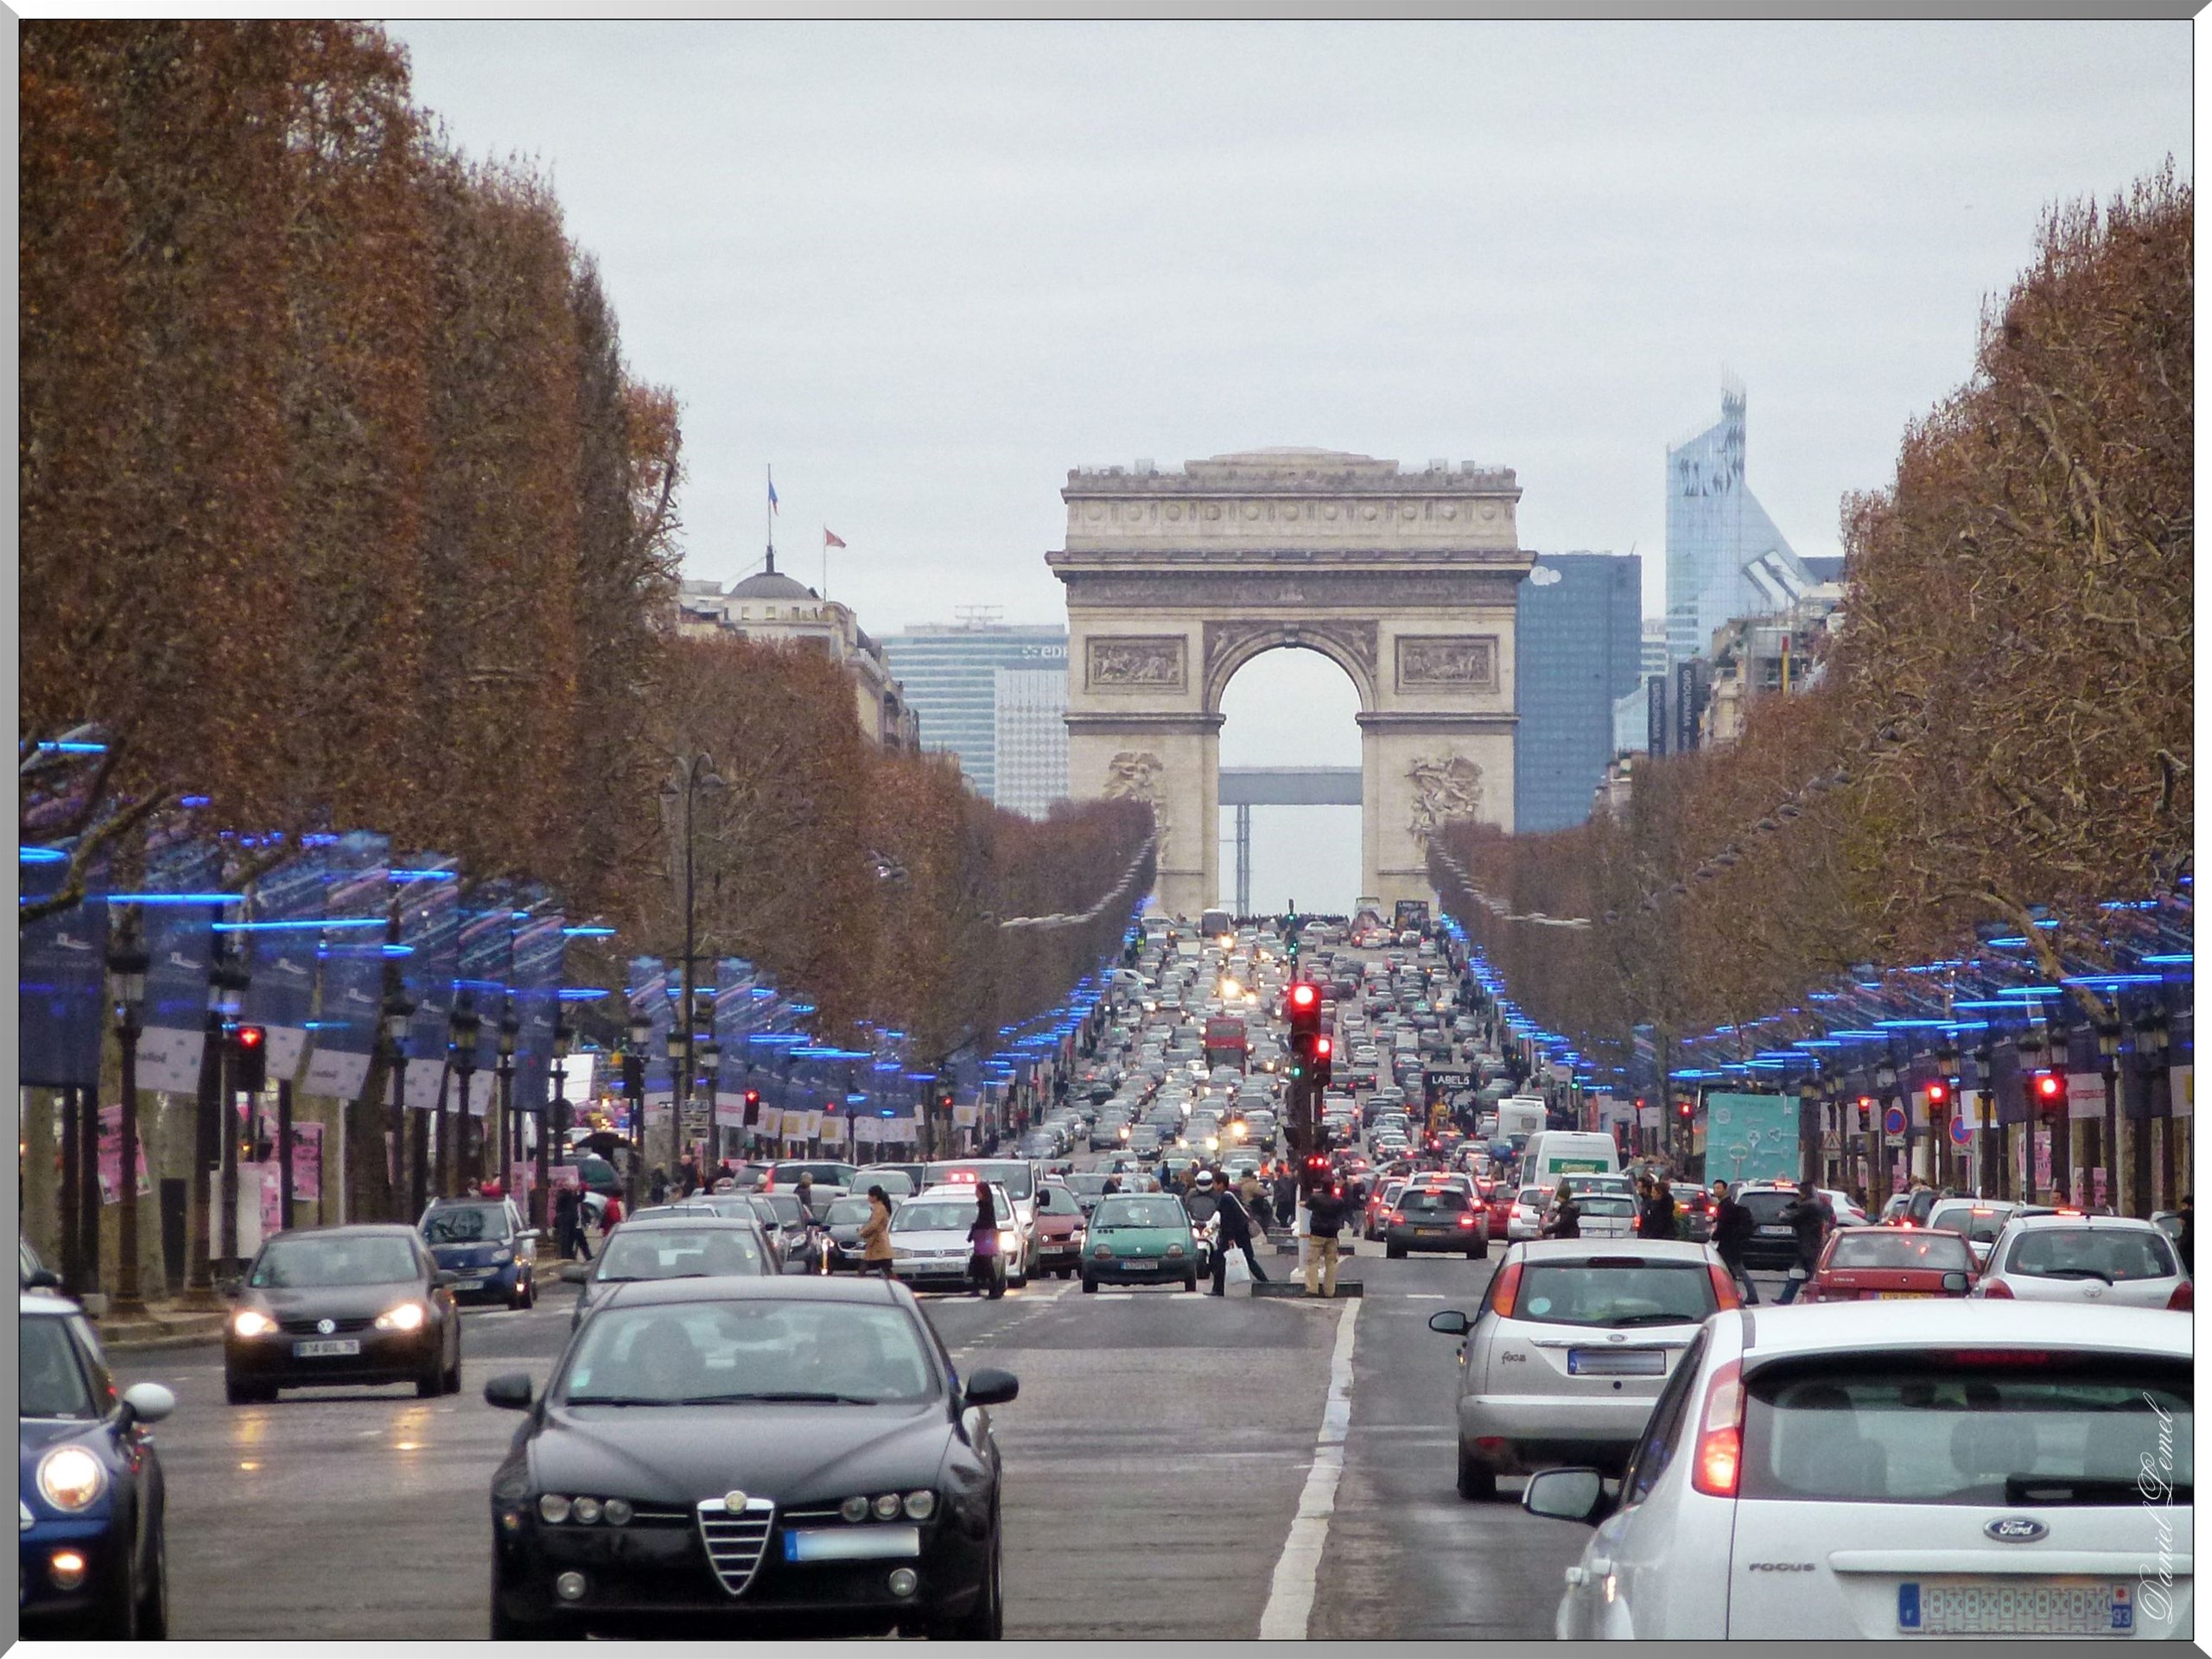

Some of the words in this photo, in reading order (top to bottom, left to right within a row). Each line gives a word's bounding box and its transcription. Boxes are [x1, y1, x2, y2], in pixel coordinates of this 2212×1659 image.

[1682, 670, 1692, 727] GROUPAMA
[1999, 1521, 2032, 1536] Ford
[1749, 1562, 1816, 1573] FOCUS
[2113, 1609, 2132, 1625] 93
